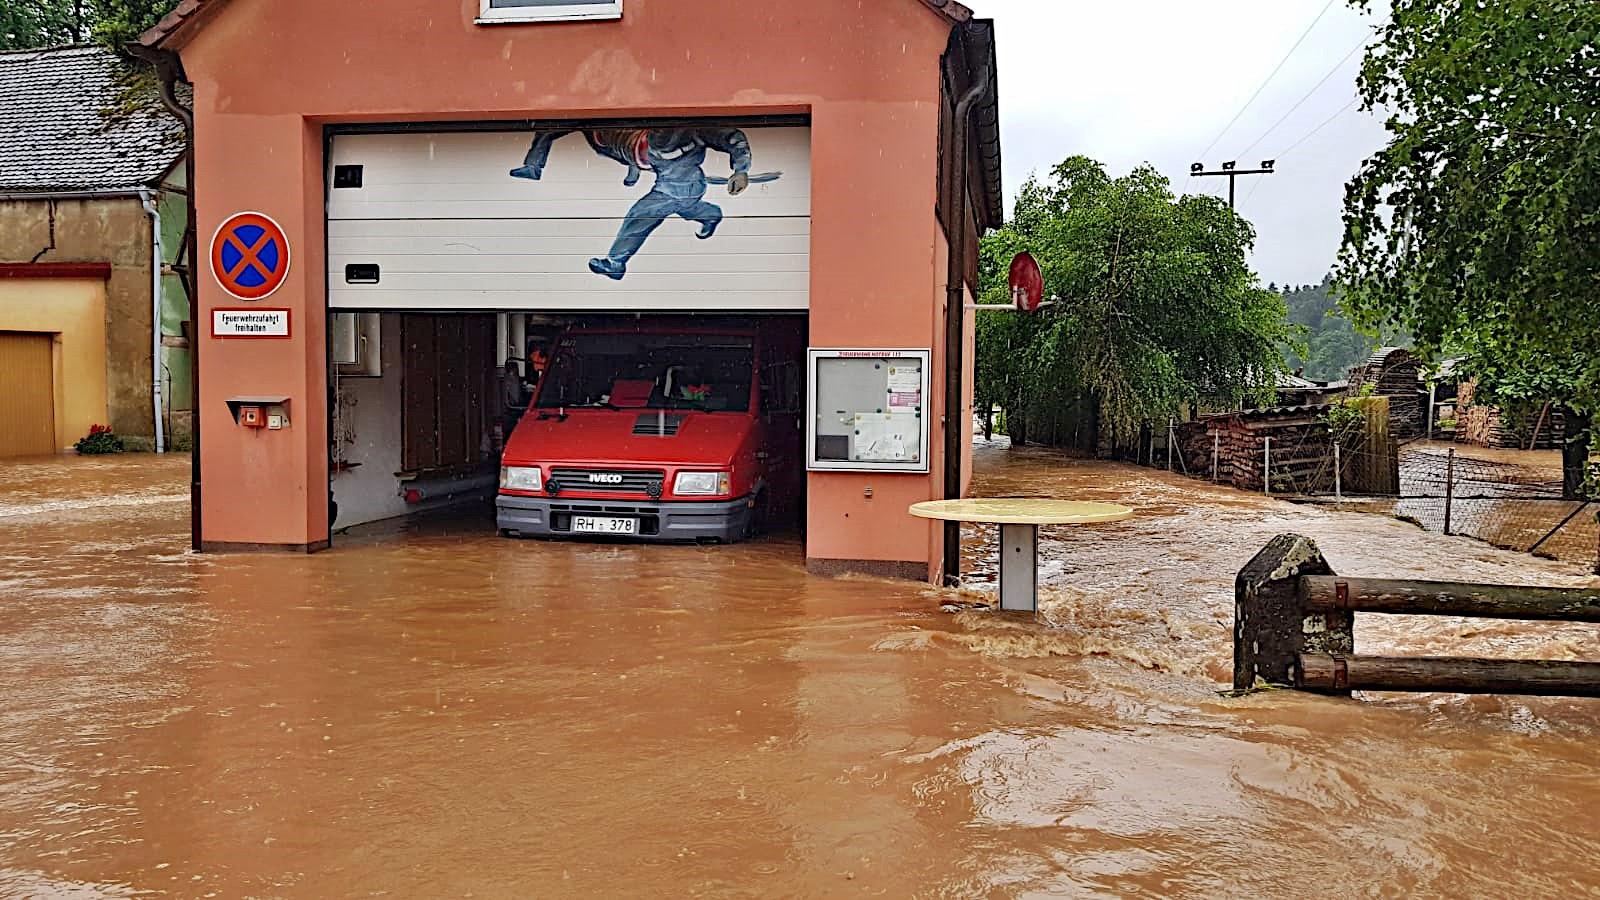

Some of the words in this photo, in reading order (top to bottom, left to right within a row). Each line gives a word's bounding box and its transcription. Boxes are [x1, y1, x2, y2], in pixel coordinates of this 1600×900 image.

[235, 323, 266, 332] freihalten
[588, 473, 623, 484] IVECO
[576, 518, 595, 530] RH
[609, 519, 632, 531] 378
